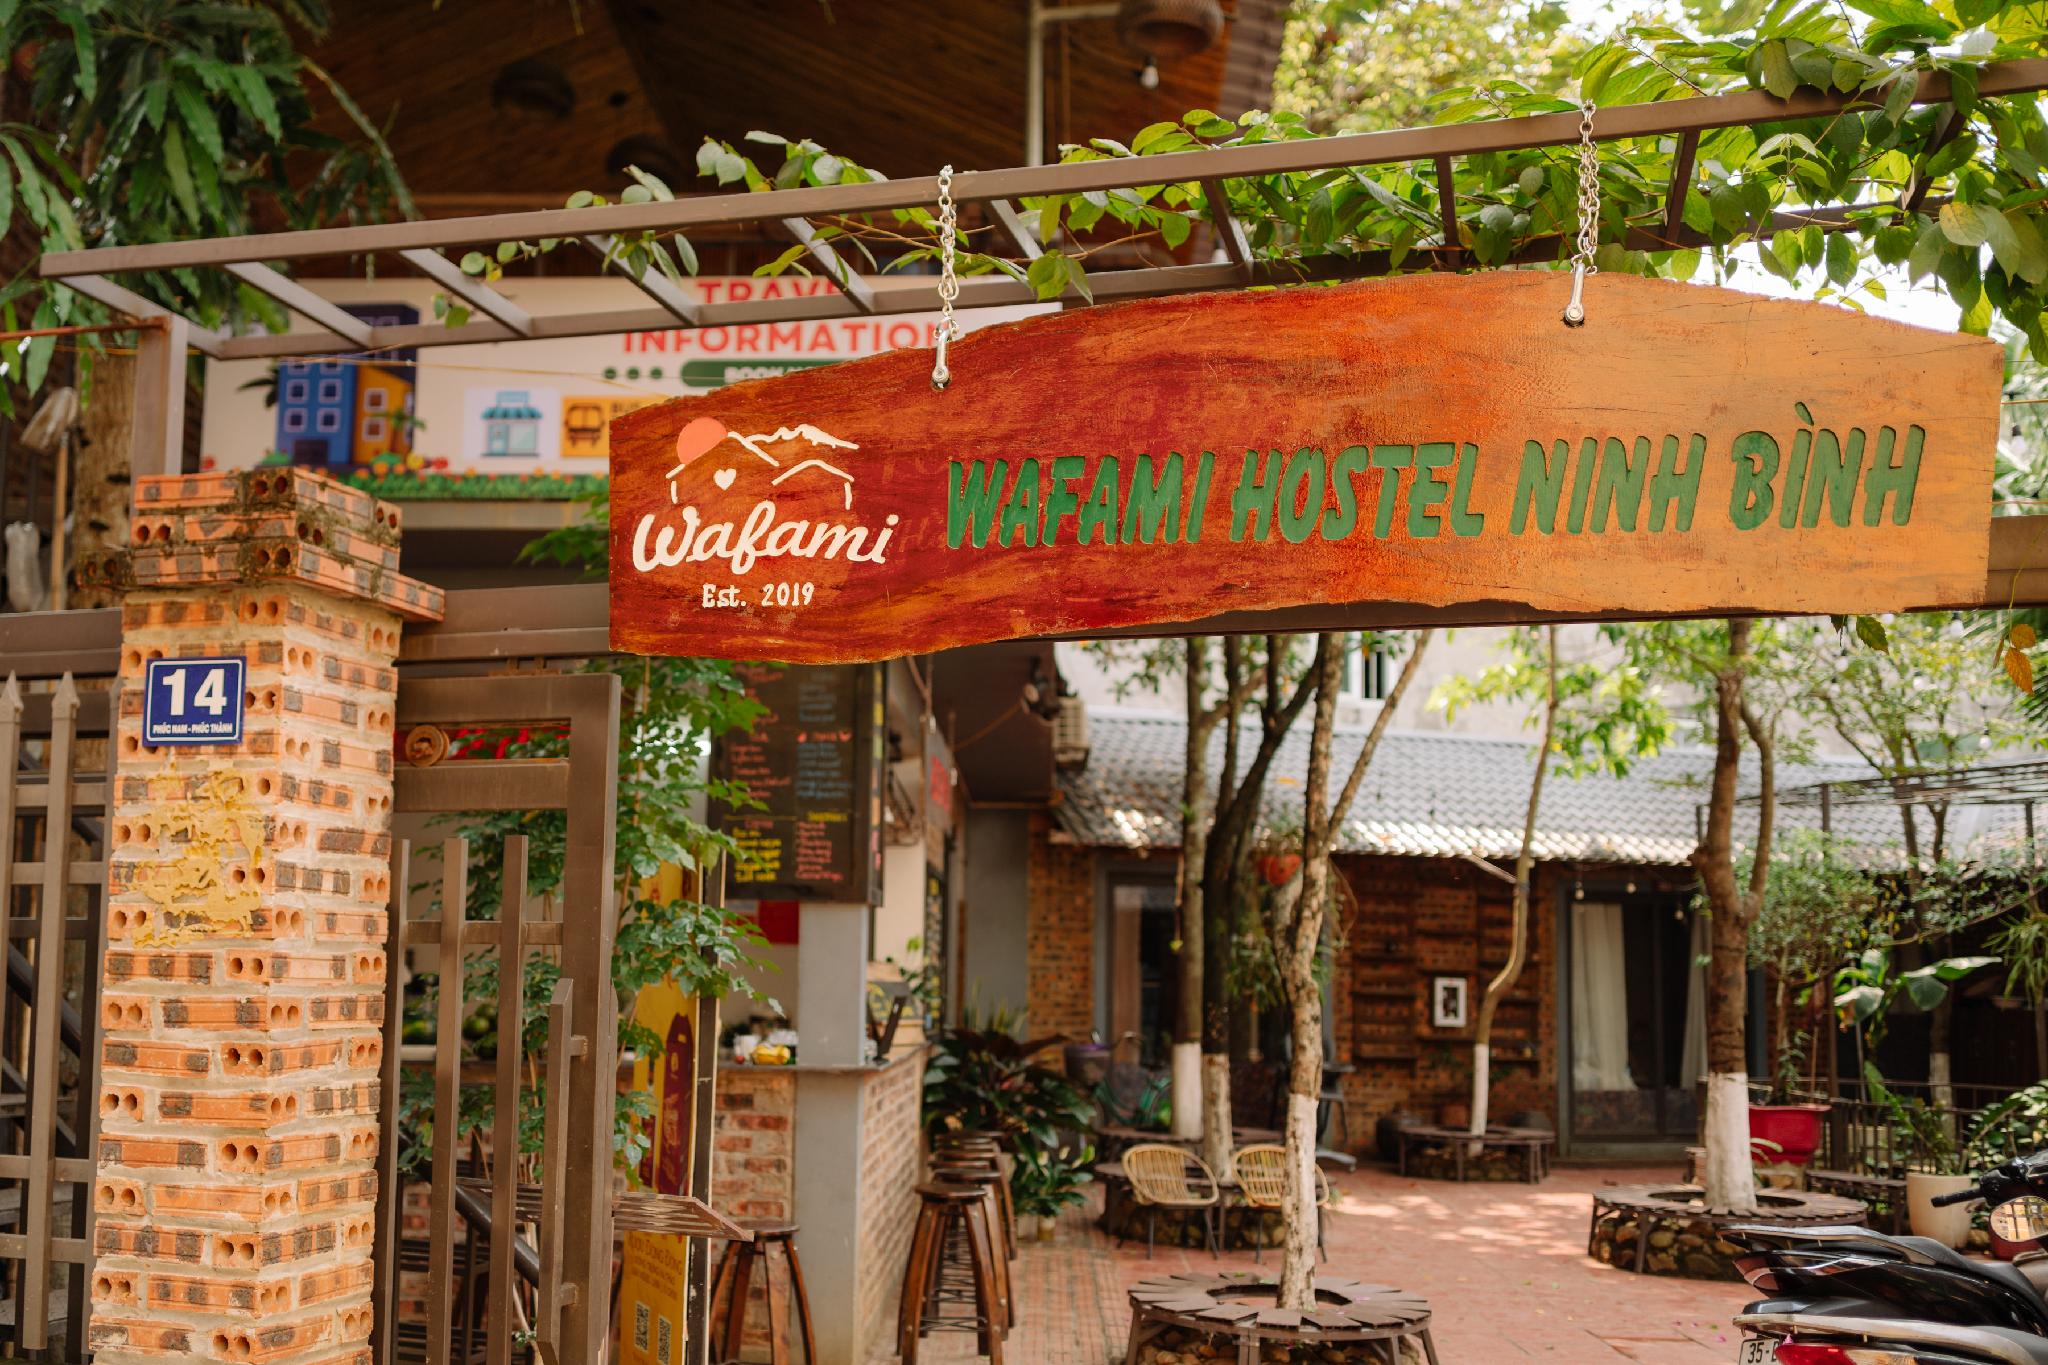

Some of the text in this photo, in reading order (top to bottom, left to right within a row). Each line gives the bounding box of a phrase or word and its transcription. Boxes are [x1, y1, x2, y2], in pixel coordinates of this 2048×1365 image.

[696, 279, 843, 305] TRAV
[947, 401, 1926, 549] WAFAMI HOSTEL NINH BÌNH
[632, 499, 900, 575] Wafami
[702, 581, 815, 609] Est. 2019
[162, 668, 227, 716] 14
